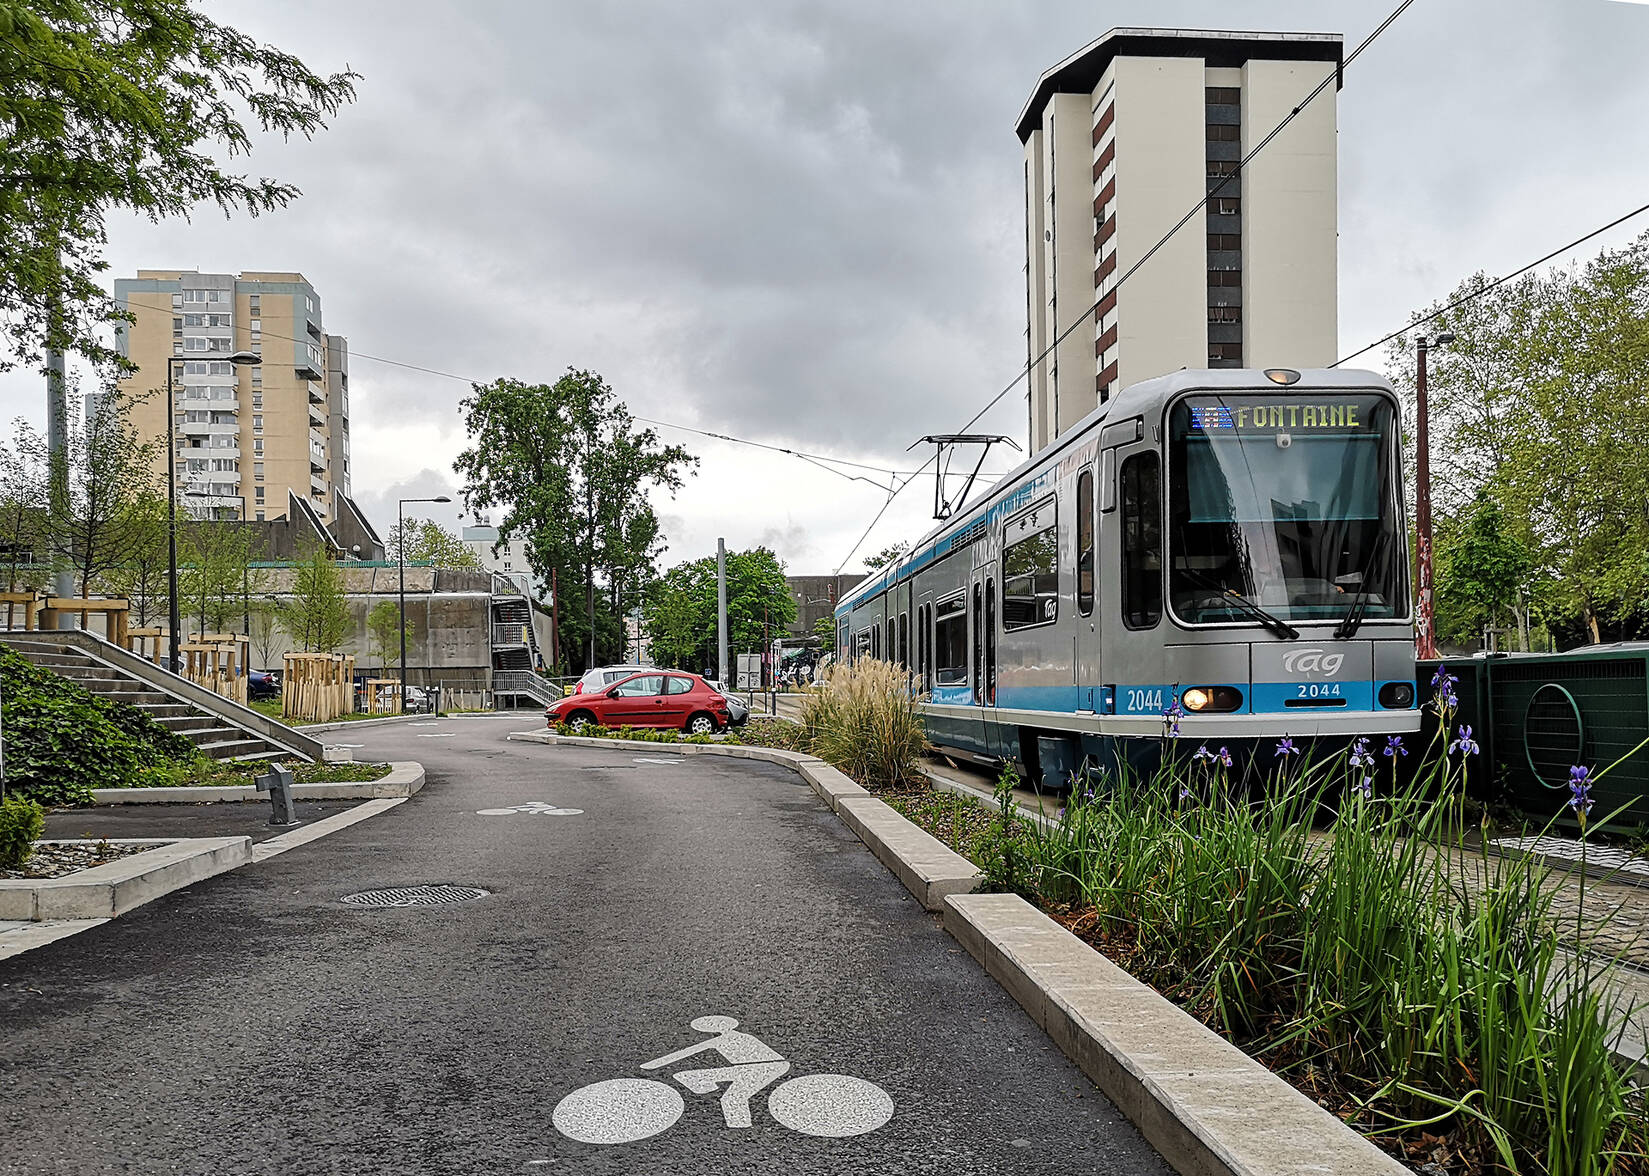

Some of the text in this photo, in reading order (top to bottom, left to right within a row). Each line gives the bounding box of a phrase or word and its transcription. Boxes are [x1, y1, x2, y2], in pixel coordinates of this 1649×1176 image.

[1238, 405, 1360, 428] FONTAINE
[1127, 689, 1163, 711] 2044
[1298, 684, 1341, 698] 2044
